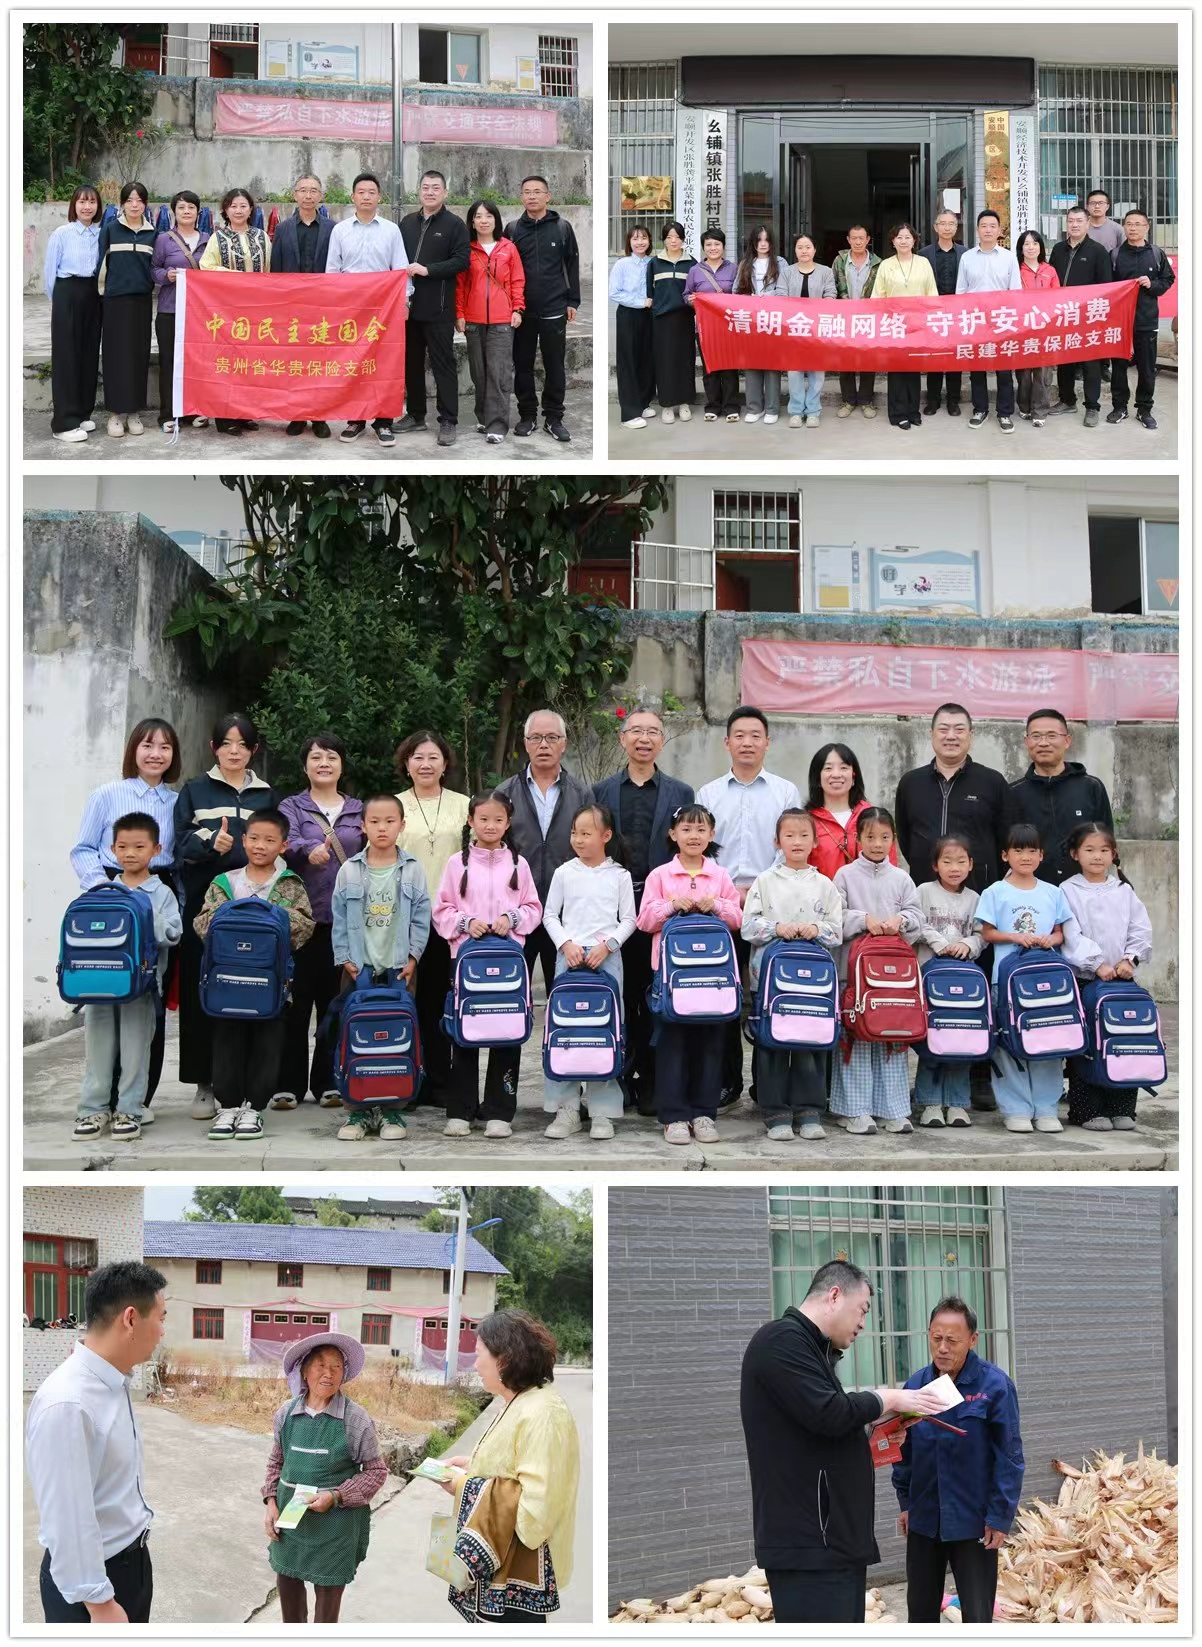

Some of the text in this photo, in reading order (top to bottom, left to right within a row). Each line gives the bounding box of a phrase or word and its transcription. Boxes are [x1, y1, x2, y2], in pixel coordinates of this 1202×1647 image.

[205, 312, 387, 345] 中国民主建国会
[724, 296, 1112, 340] 清朗金融网络 守护安心消费
[215, 356, 377, 377] 贵州省华贵保险支部
[776, 655, 1057, 693] 严禁私自下水游泳
